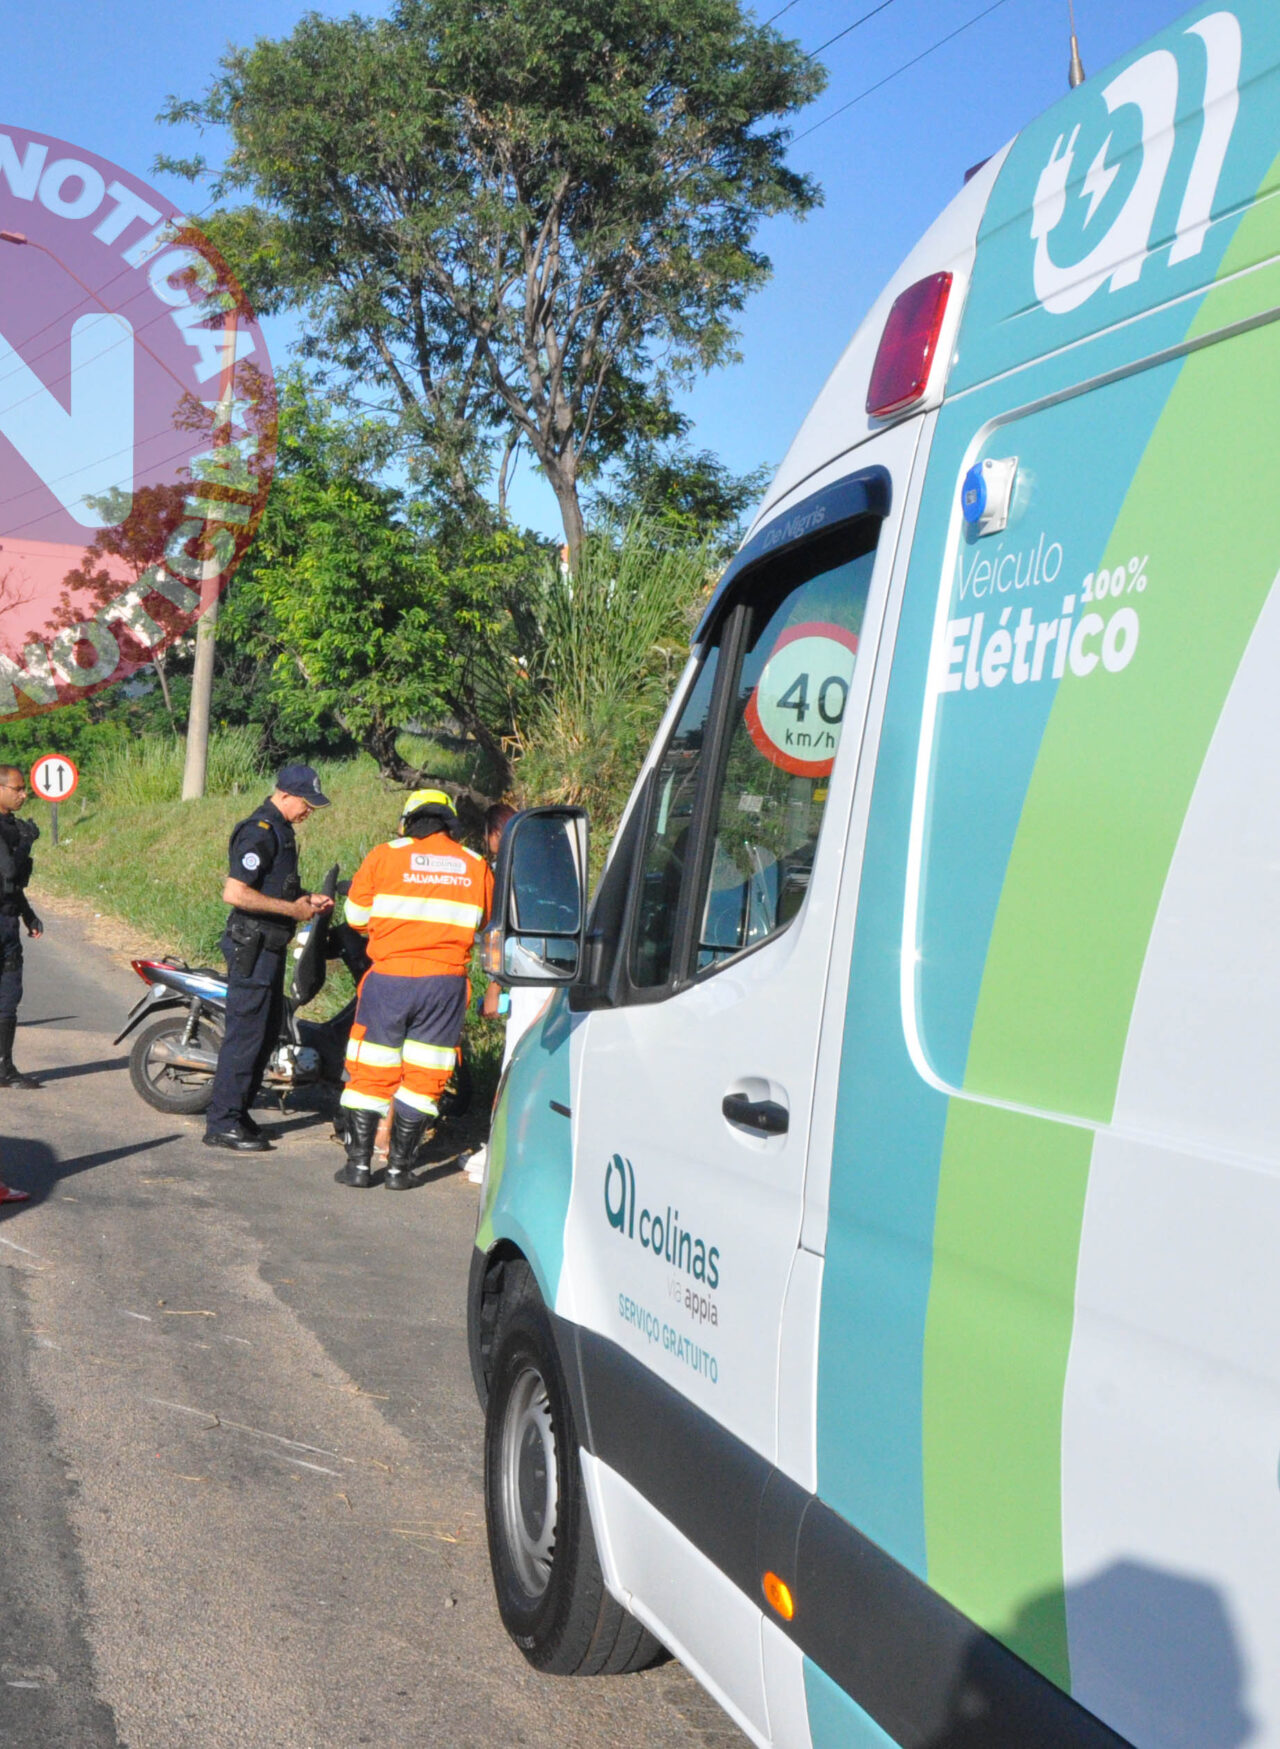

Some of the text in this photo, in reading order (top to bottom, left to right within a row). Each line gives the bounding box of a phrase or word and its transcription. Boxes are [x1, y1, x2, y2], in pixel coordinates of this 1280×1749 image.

[959, 531, 1063, 600] Veículo
[1080, 554, 1149, 603] 100%
[938, 594, 1139, 693] Elétrico
[776, 672, 849, 724] 40
[785, 728, 835, 748] km/h
[402, 872, 472, 887] SALVAMENTO
[639, 1205, 720, 1290] colinas
[666, 1271, 719, 1326] via appia
[617, 1292, 719, 1384] SERVIÇO GRATUITO
